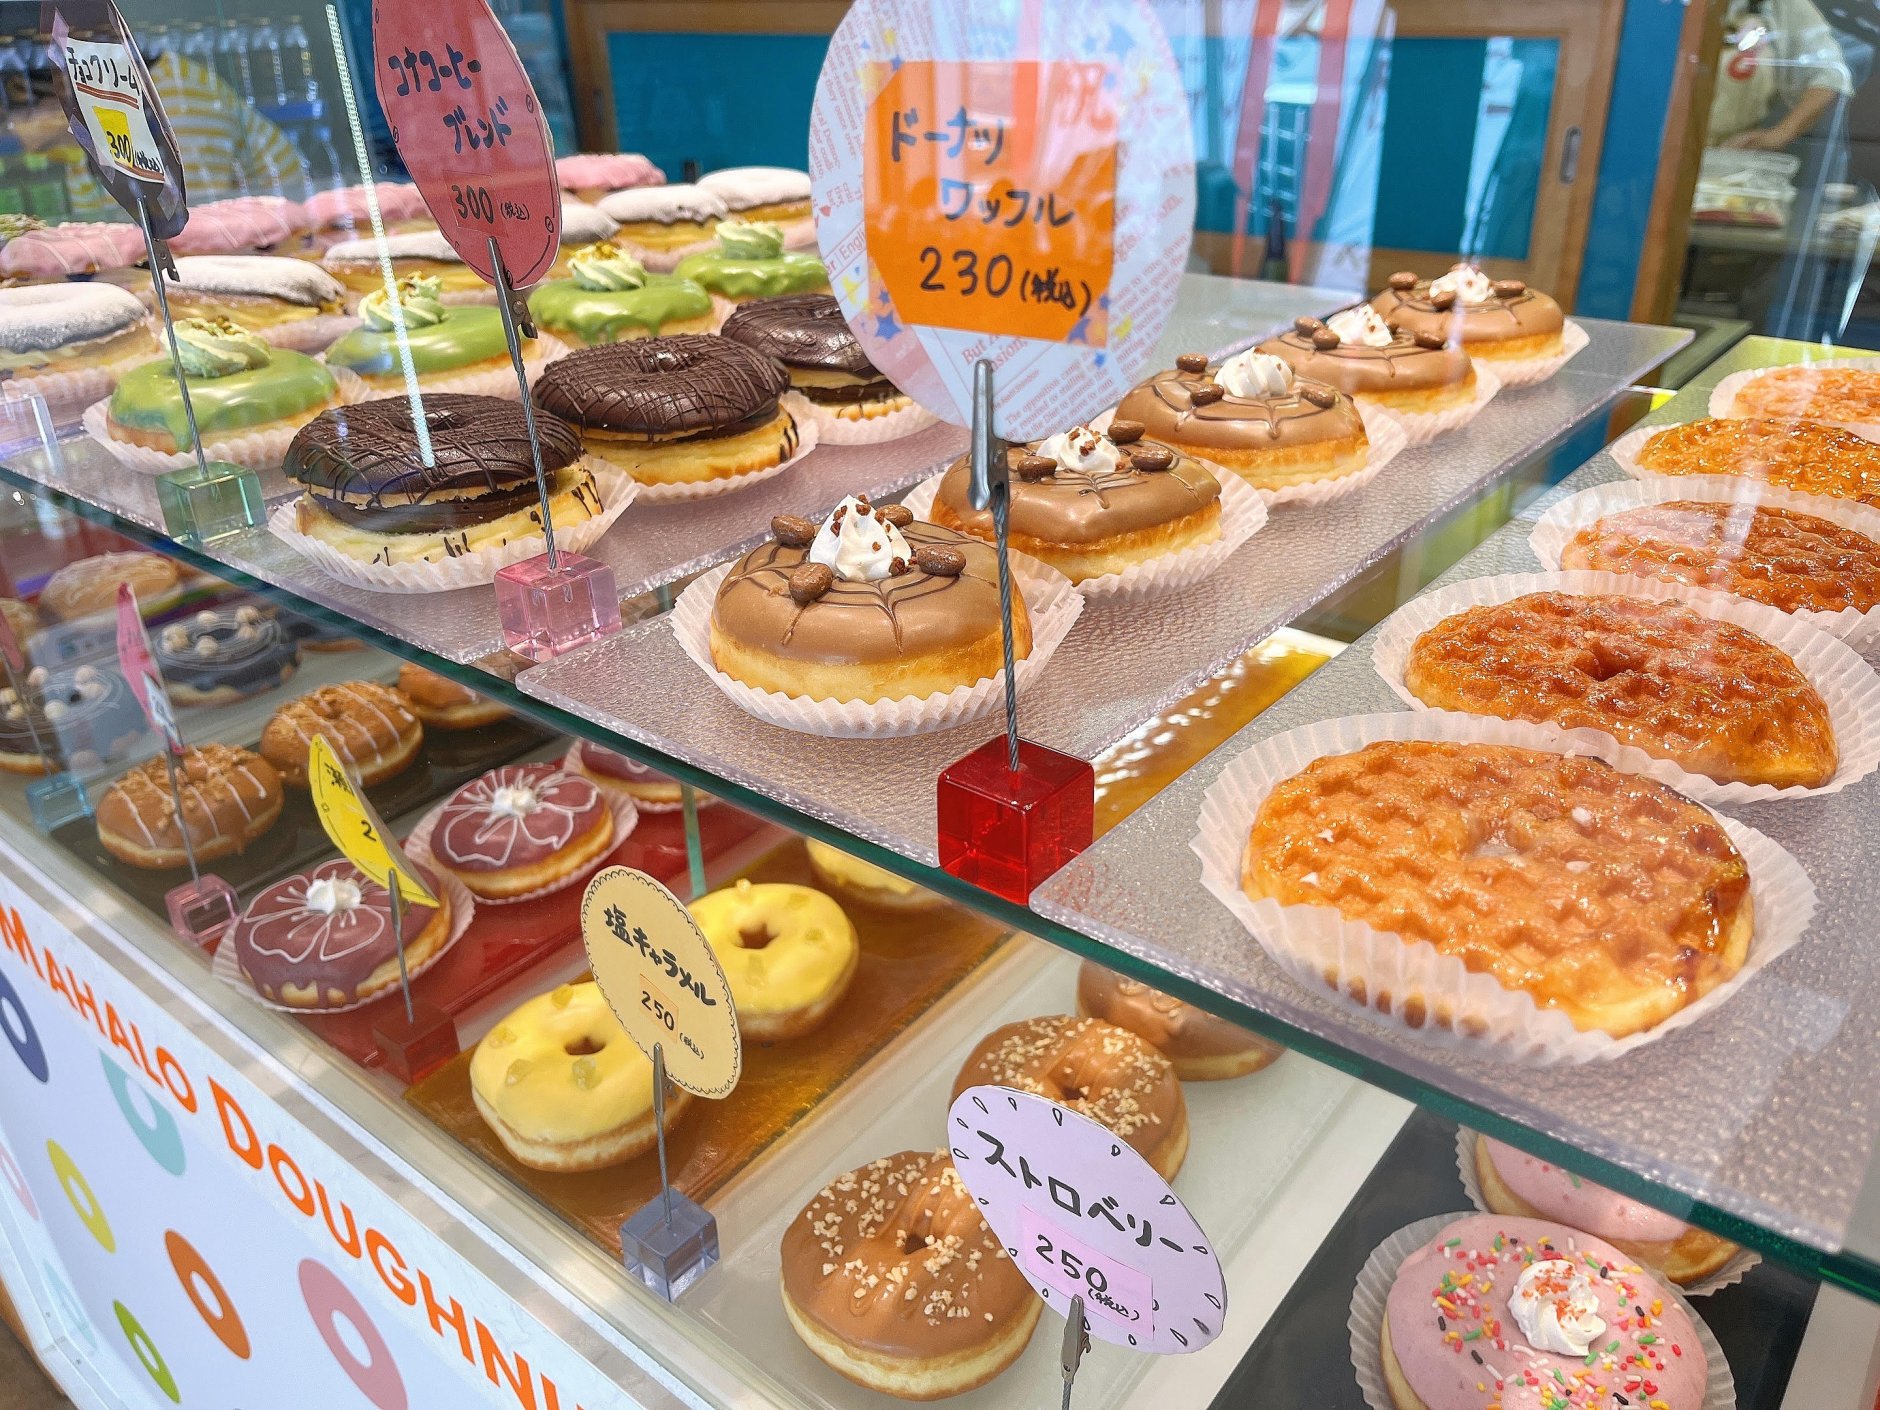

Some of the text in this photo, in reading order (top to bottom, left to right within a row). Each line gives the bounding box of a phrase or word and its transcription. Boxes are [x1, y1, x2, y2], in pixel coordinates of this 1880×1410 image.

[388, 43, 481, 96] コナコーヒー
[443, 96, 512, 153] ブレンド
[451, 185, 494, 224] 300
[941, 178, 1074, 228] ワッフル
[920, 247, 1013, 297] 230
[604, 903, 717, 1006] 塩キャラメル
[0, 900, 199, 1115] MAHALO
[641, 990, 675, 1031] 250
[976, 1130, 1184, 1252] ストロベリー
[1035, 1234, 1108, 1293] 250
